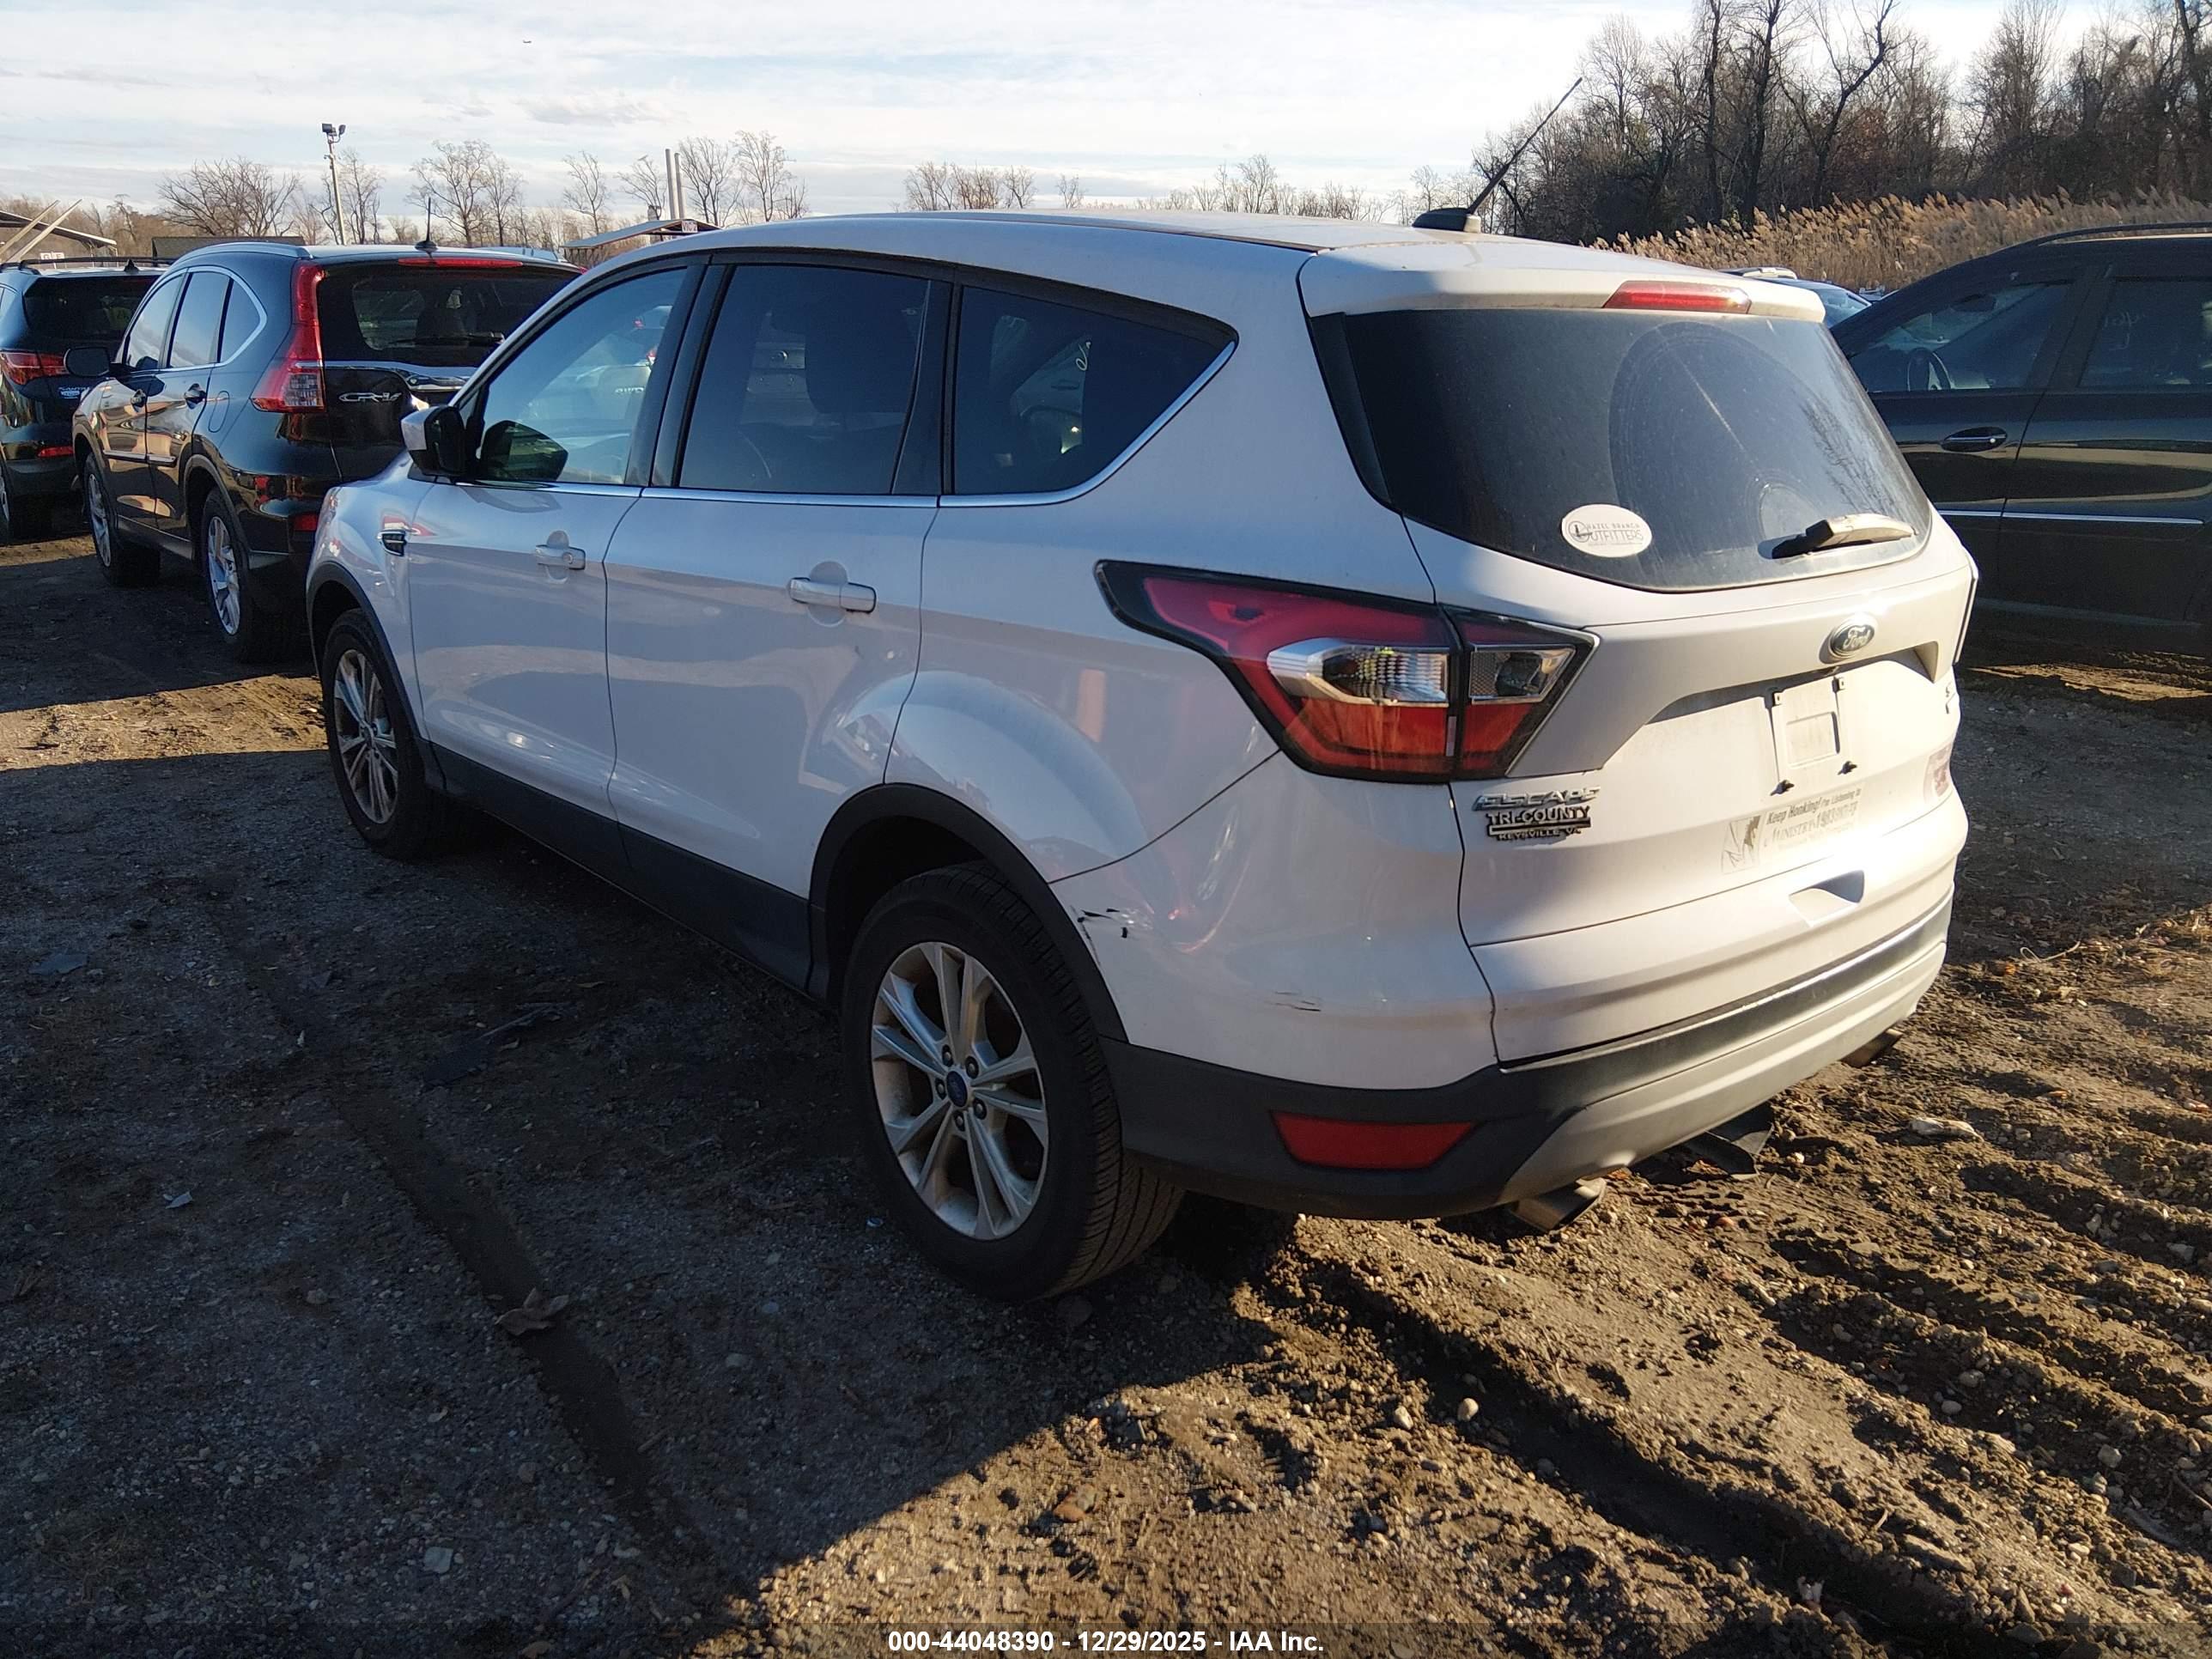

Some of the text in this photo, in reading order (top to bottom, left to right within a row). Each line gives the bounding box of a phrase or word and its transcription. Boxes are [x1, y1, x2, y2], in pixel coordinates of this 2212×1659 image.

[338, 392, 402, 402] CR-V
[1842, 626, 1872, 650] Ford
[1472, 787, 1600, 811] ESCAPE
[1486, 805, 1589, 825] TRI-COUNTY
[1767, 811, 1787, 824] Keep
[1788, 797, 1821, 818] Honking!
[1497, 828, 1561, 841] KEYSVILLE
